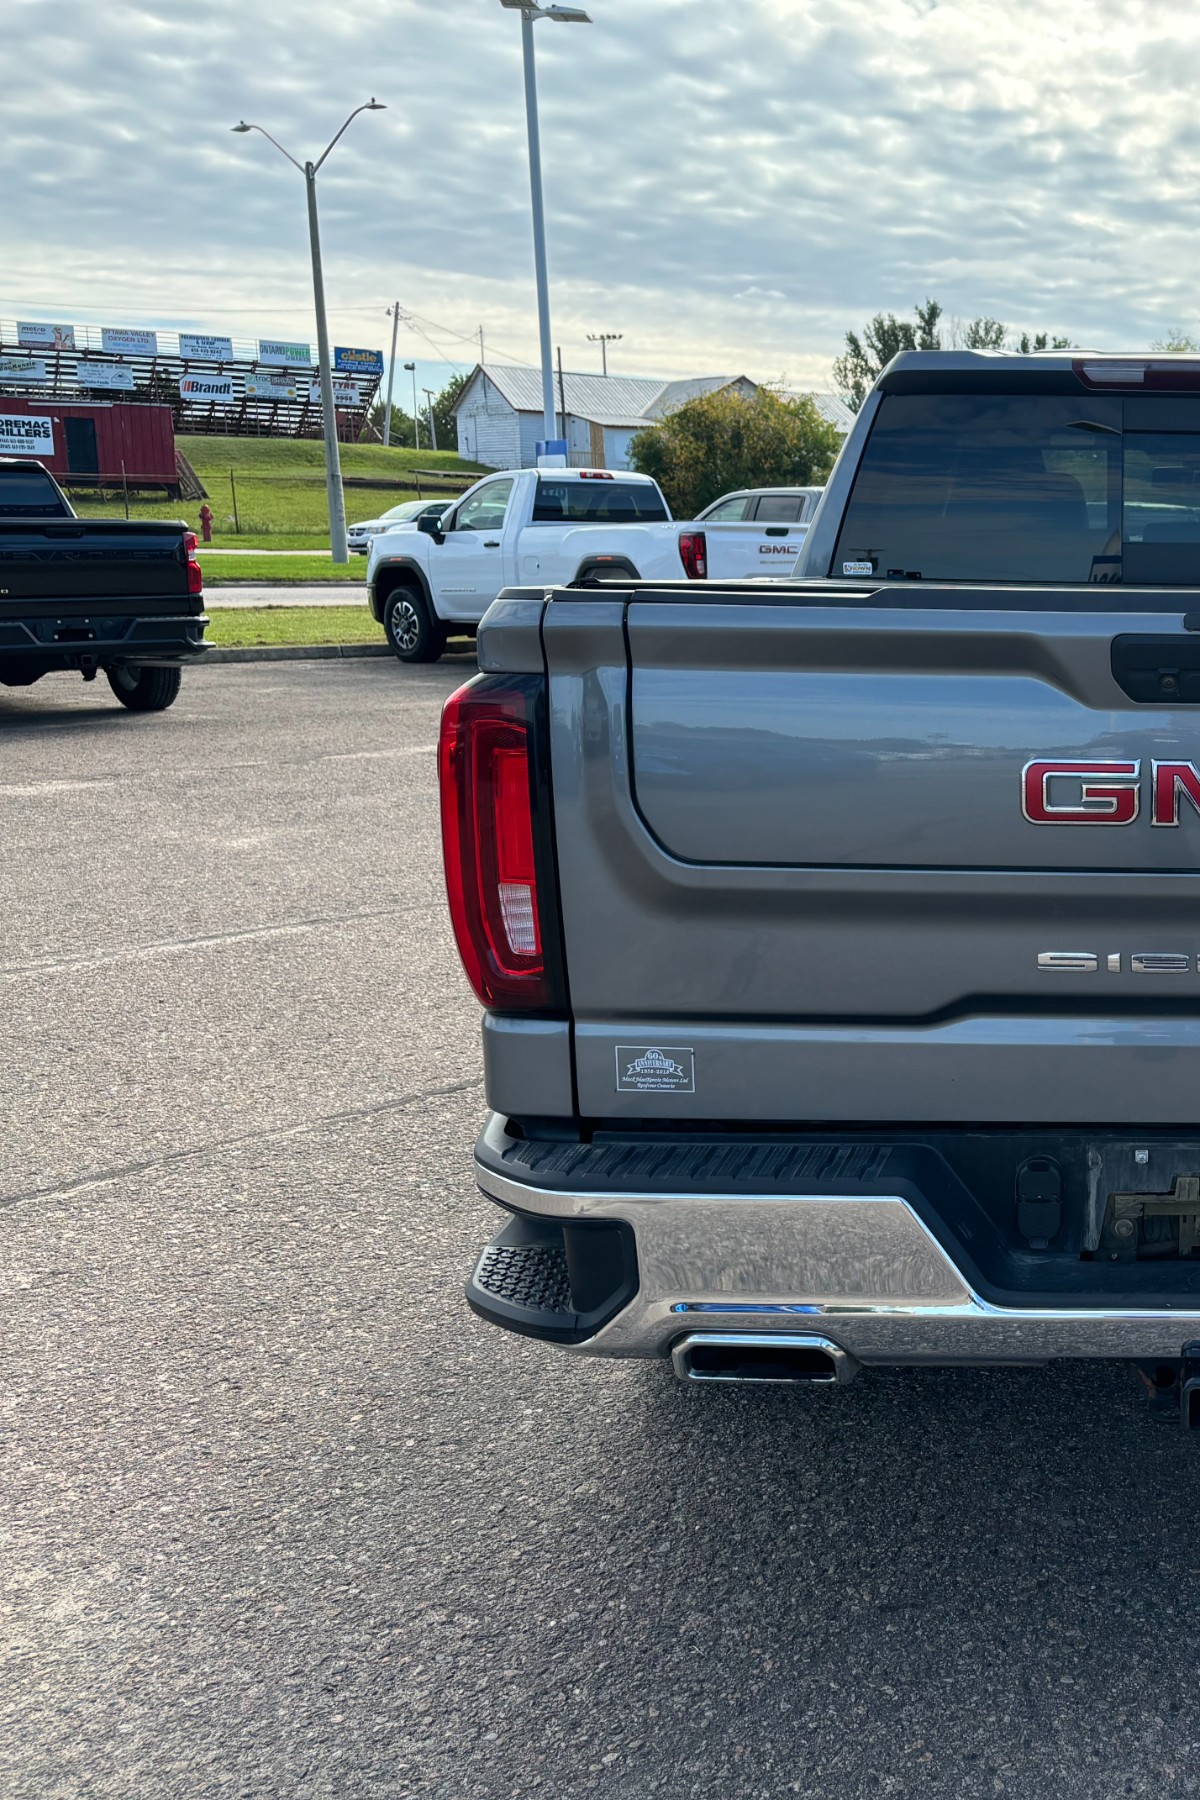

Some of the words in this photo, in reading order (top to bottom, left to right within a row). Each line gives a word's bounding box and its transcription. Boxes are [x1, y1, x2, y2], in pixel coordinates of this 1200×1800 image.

[102, 328, 129, 336] OTTAWA
[131, 330, 155, 338] VALLEY
[108, 335, 136, 343] OXYGEN
[260, 344, 285, 355] ONTARIO
[286, 346, 310, 357] POWER
[191, 381, 231, 394] Brandt
[758, 544, 799, 555] GMC
[637, 1060, 673, 1068] ANNIVERSARY
